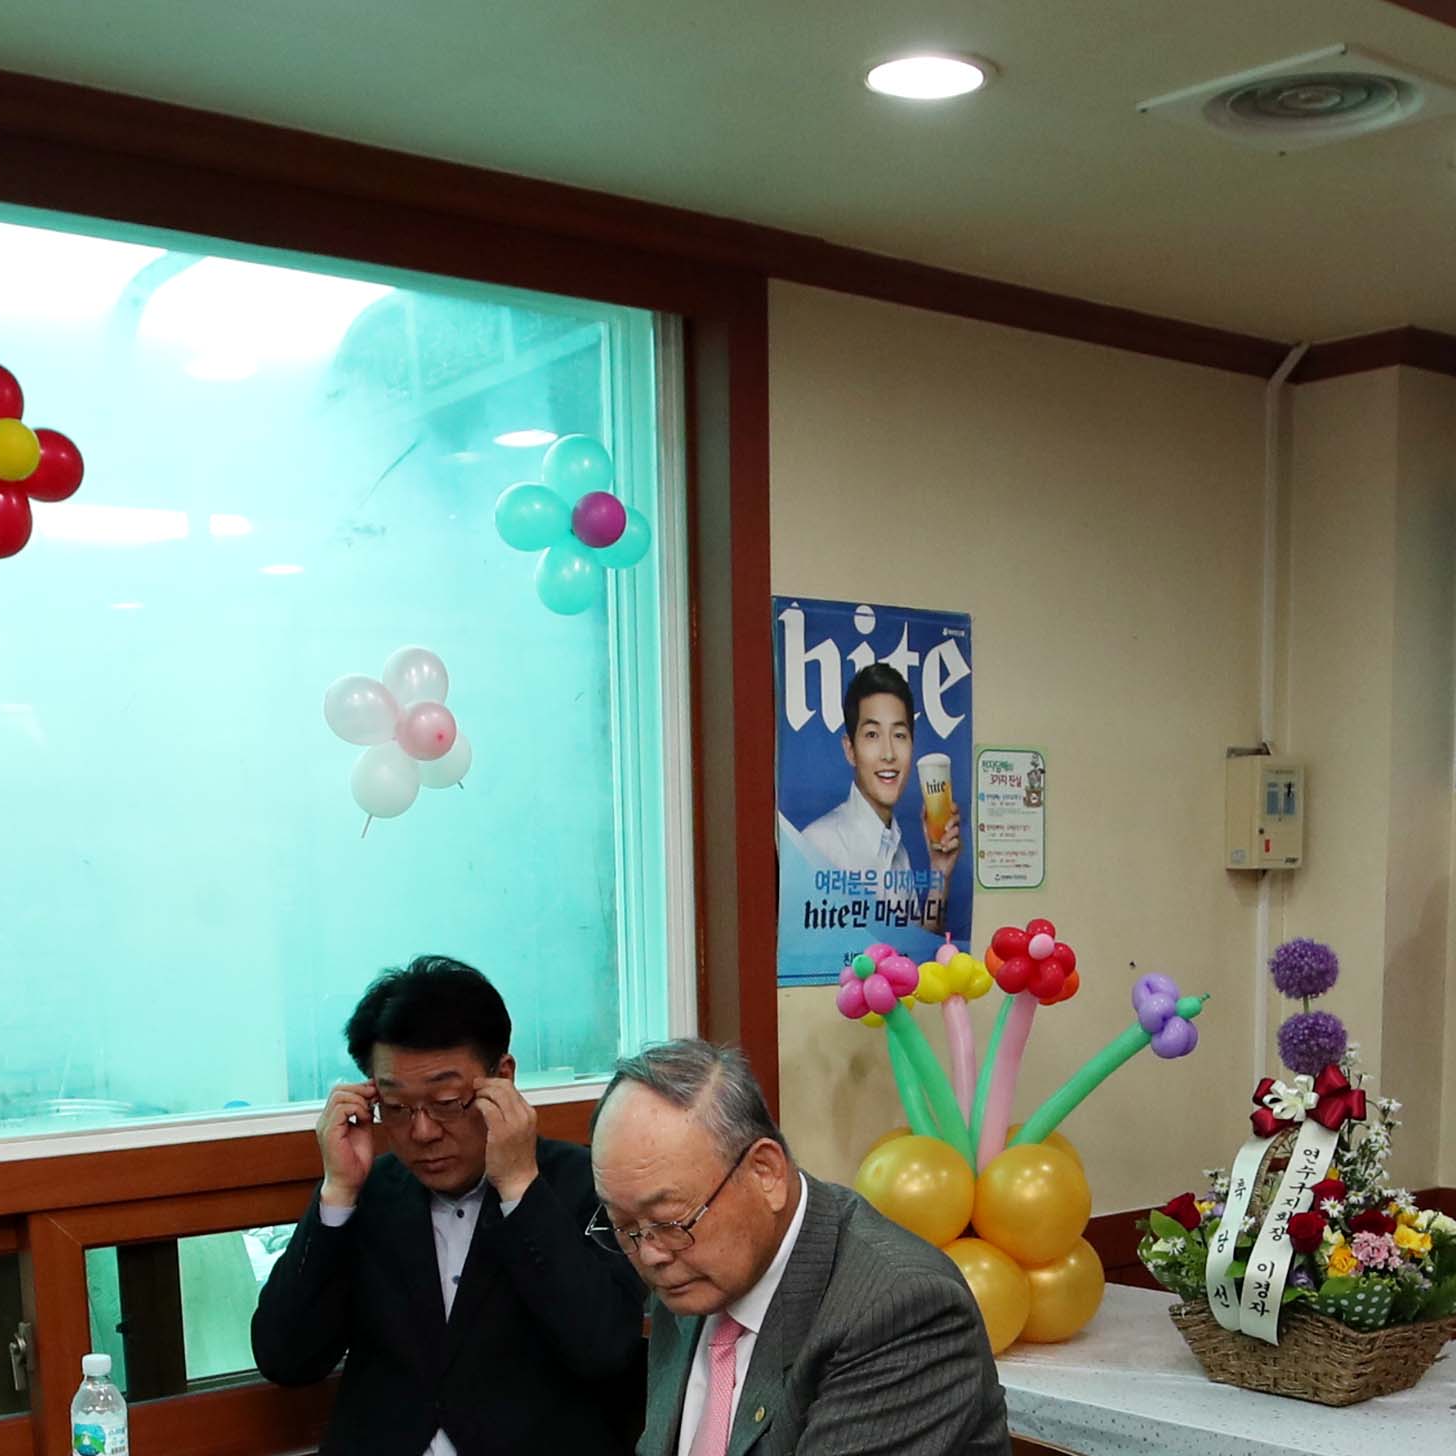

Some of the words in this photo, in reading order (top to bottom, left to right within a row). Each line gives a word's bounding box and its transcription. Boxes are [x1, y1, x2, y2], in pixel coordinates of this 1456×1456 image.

[778, 601, 972, 740] hite
[815, 869, 878, 895] 여러분은
[884, 869, 944, 893] 이제부터
[804, 898, 870, 929] hite만
[875, 899, 948, 928] 마십니다
[1249, 1261, 1275, 1317] 이경자
